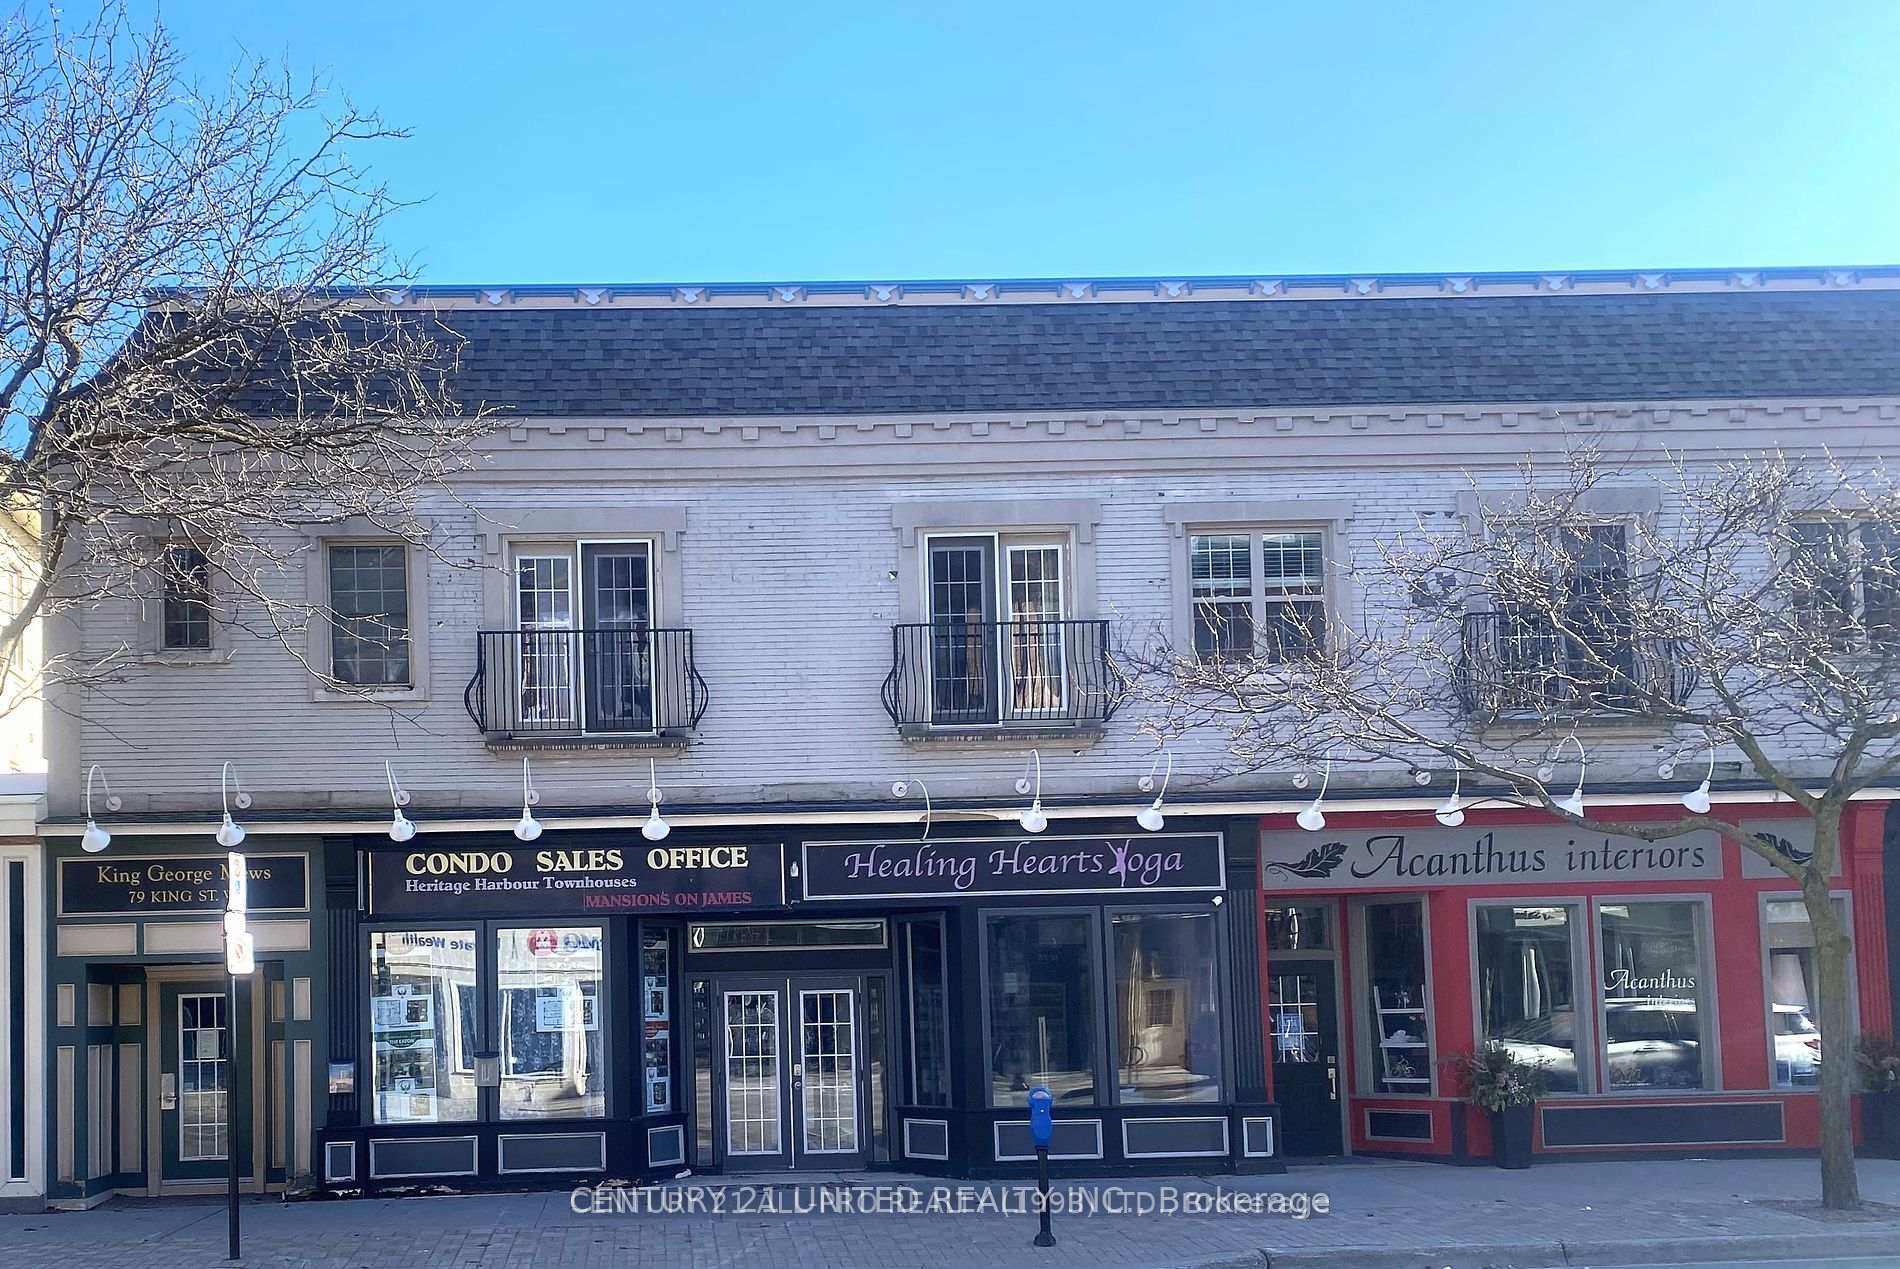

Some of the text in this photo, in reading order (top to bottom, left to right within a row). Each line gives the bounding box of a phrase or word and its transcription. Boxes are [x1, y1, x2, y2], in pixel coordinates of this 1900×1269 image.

[404, 846, 749, 875] CONDO SALES OFFICE
[844, 842, 977, 890] Healing
[988, 841, 1104, 876] Hearts
[1351, 832, 1705, 878] Acanthus interiors
[97, 864, 141, 885] King
[147, 864, 213, 886] George
[219, 863, 272, 881] Mws
[405, 875, 637, 895] Heritage Harbour Townhouses
[128, 891, 145, 904] 79
[151, 890, 192, 903] KING
[199, 889, 219, 903] ST.
[584, 891, 753, 908] MANSIONS ON JAMES
[1604, 968, 1696, 991] Acanthus
